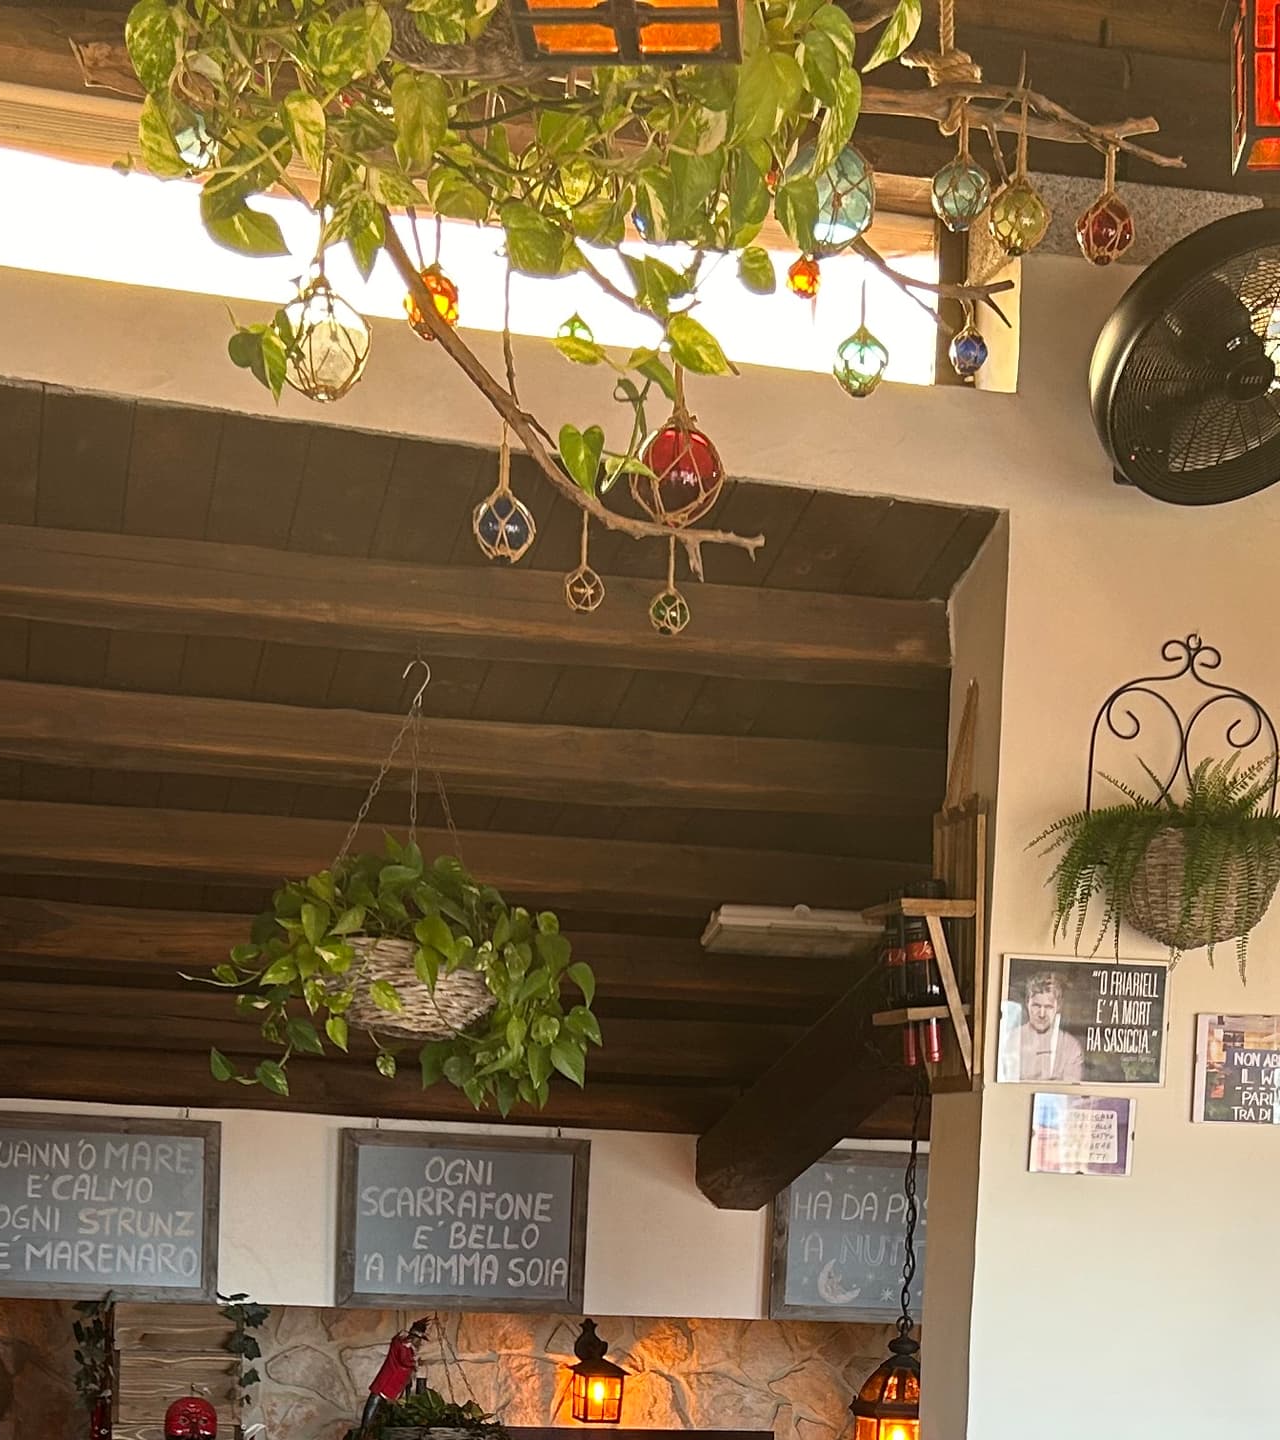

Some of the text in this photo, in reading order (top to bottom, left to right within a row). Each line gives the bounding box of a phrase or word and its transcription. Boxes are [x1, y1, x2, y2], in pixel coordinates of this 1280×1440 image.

[1110, 971, 1159, 998] FRIARIELL
[1122, 1000, 1152, 1026] MORT
[1086, 1026, 1101, 1052] RA
[1234, 1052, 1261, 1066] NON
[1241, 1068, 1254, 1084] IL
[1231, 1106, 1255, 1121] TRA
[1259, 1108, 1271, 1121] DI
[104, 1141, 194, 1175] MARE
[424, 1156, 493, 1186] OGNI
[51, 1173, 154, 1204] CALMO
[360, 1185, 554, 1222] SCARRAFONE
[794, 1190, 833, 1221] HA
[78, 1207, 195, 1239] STRUNZ
[448, 1221, 540, 1250] BELLO
[24, 1240, 198, 1278] MARENARO
[396, 1251, 499, 1286] MAMMA
[507, 1257, 569, 1287] SOIA
